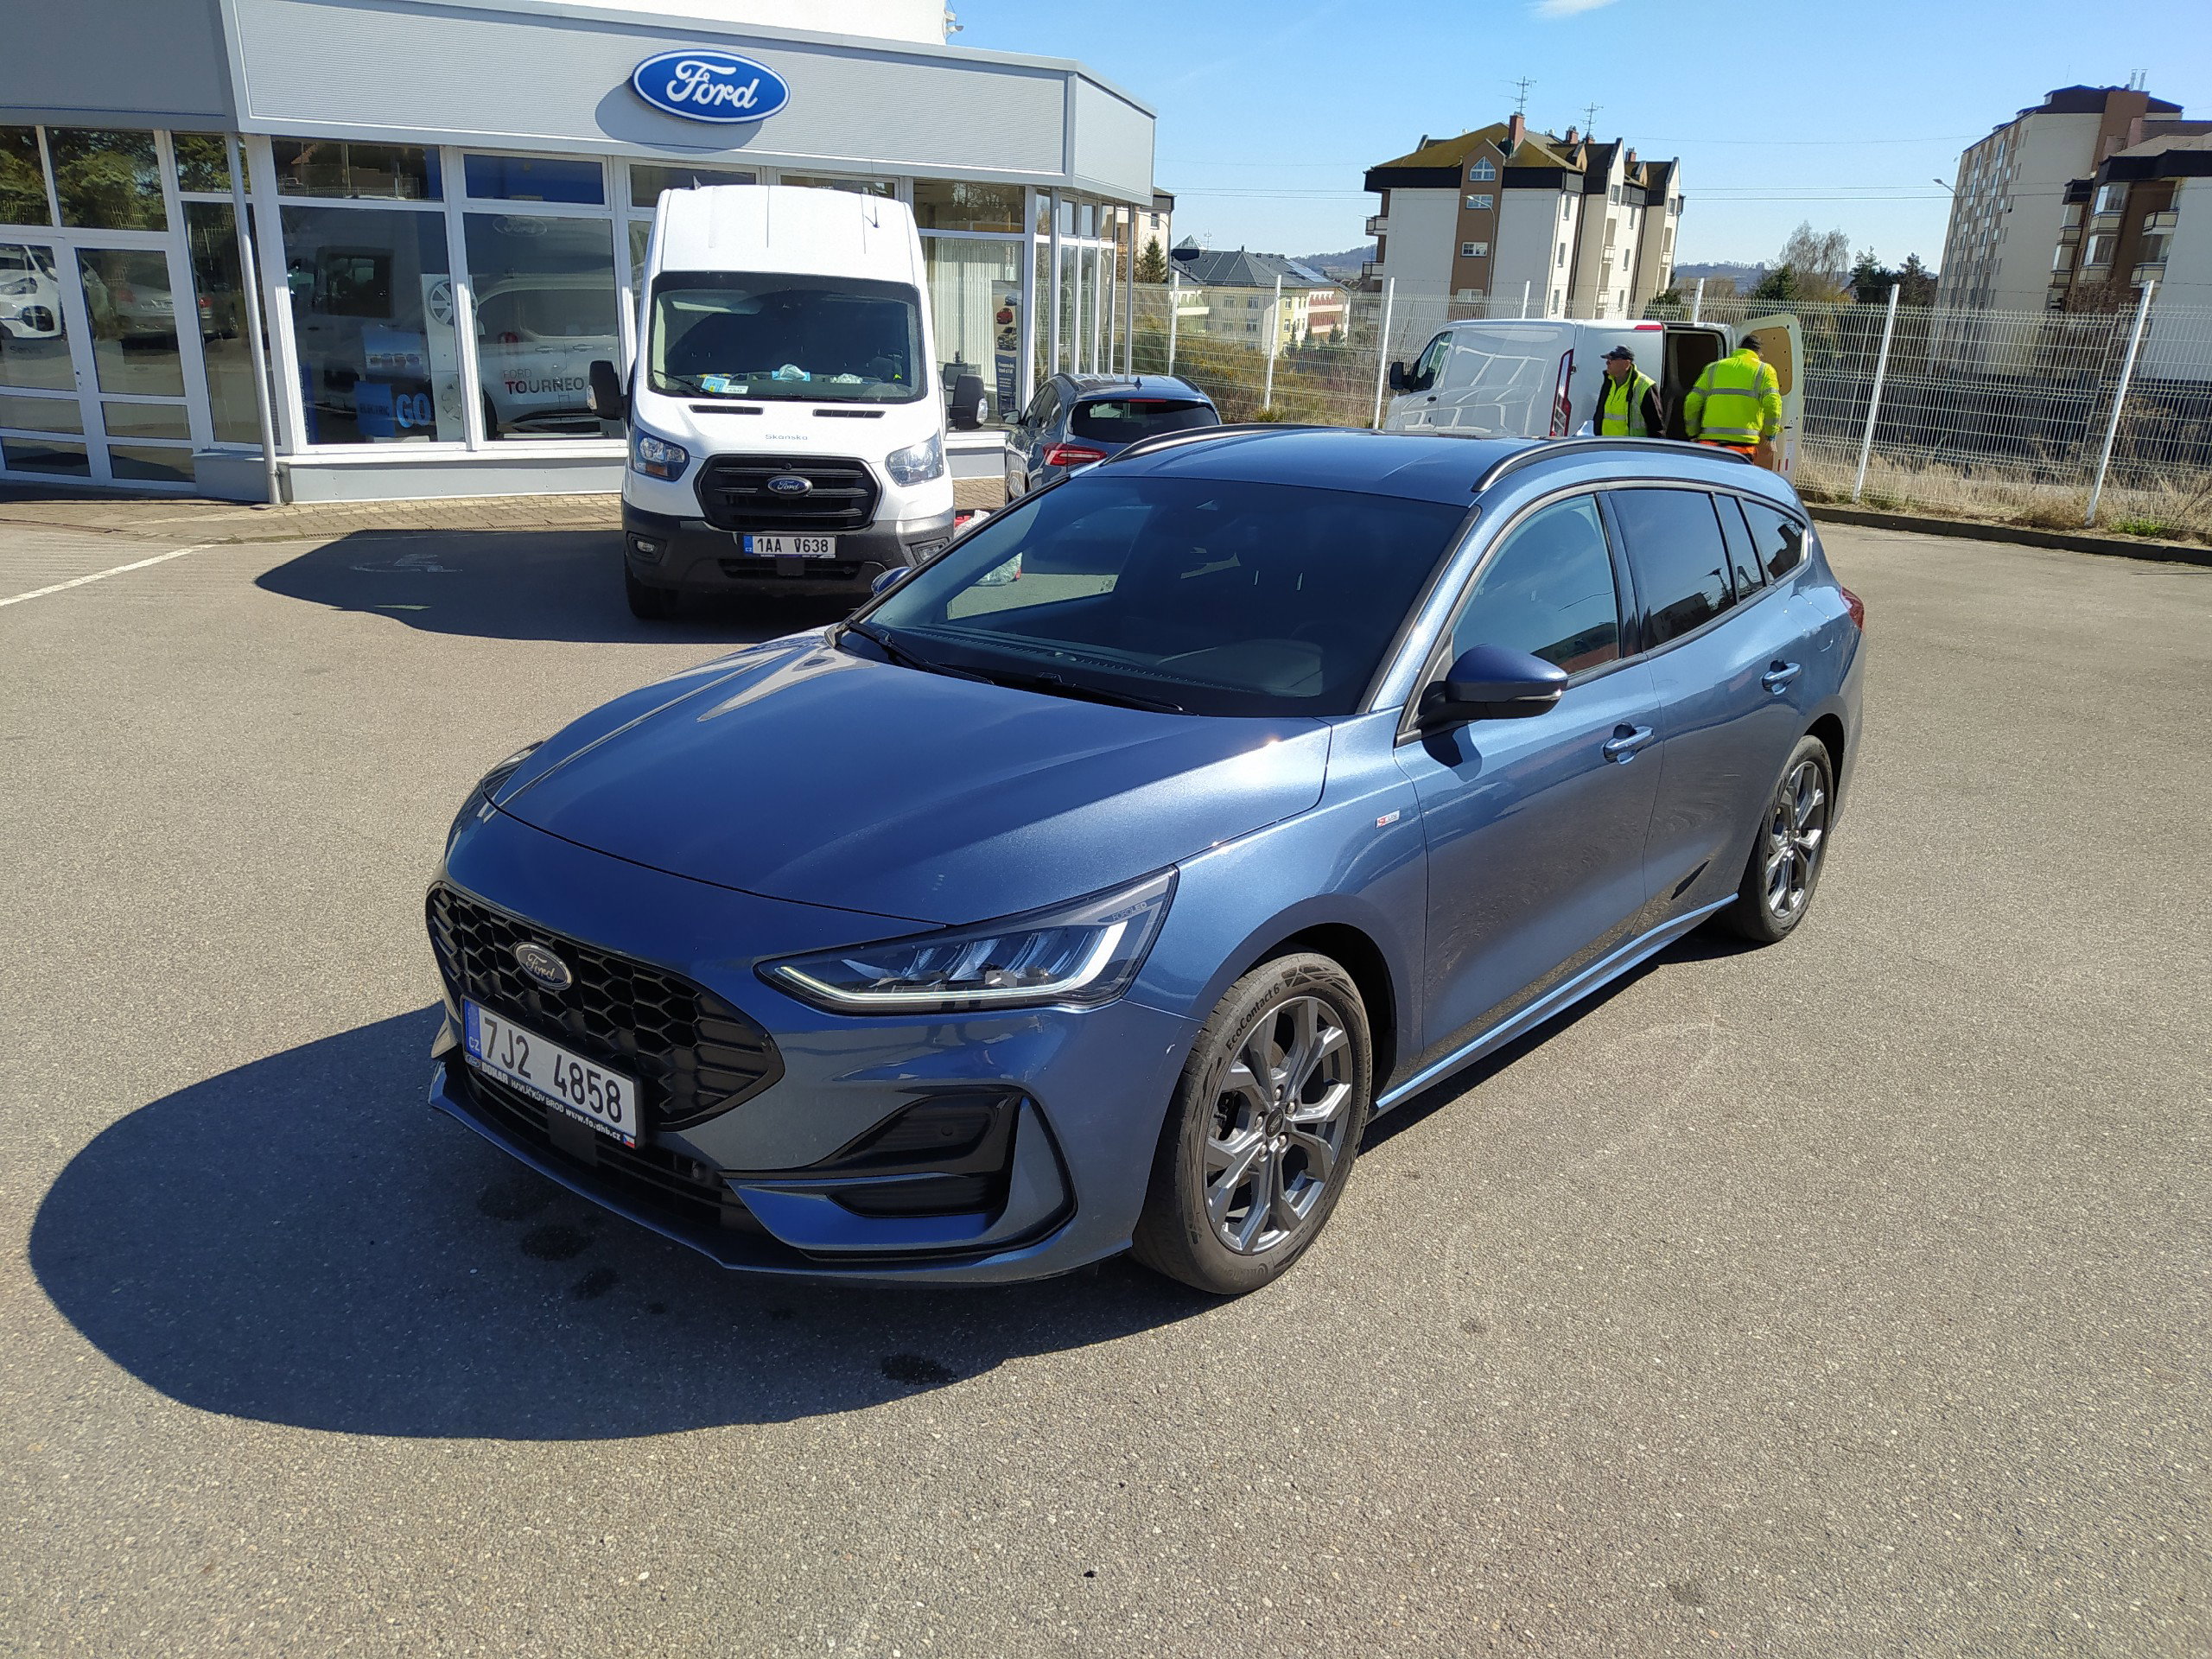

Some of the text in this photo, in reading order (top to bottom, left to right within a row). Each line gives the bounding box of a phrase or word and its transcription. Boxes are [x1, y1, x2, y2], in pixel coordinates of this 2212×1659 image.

[666, 60, 760, 109] Ford
[503, 369, 532, 378] FORD
[505, 377, 585, 395] TOURNEO
[396, 392, 431, 429] GO
[777, 480, 800, 491] Ford
[757, 537, 829, 553] 1AA V638
[525, 952, 556, 982] Ford
[468, 1036, 480, 1052] CZ
[484, 1016, 622, 1124] 7J2 4858
[545, 1096, 564, 1113] BROD
